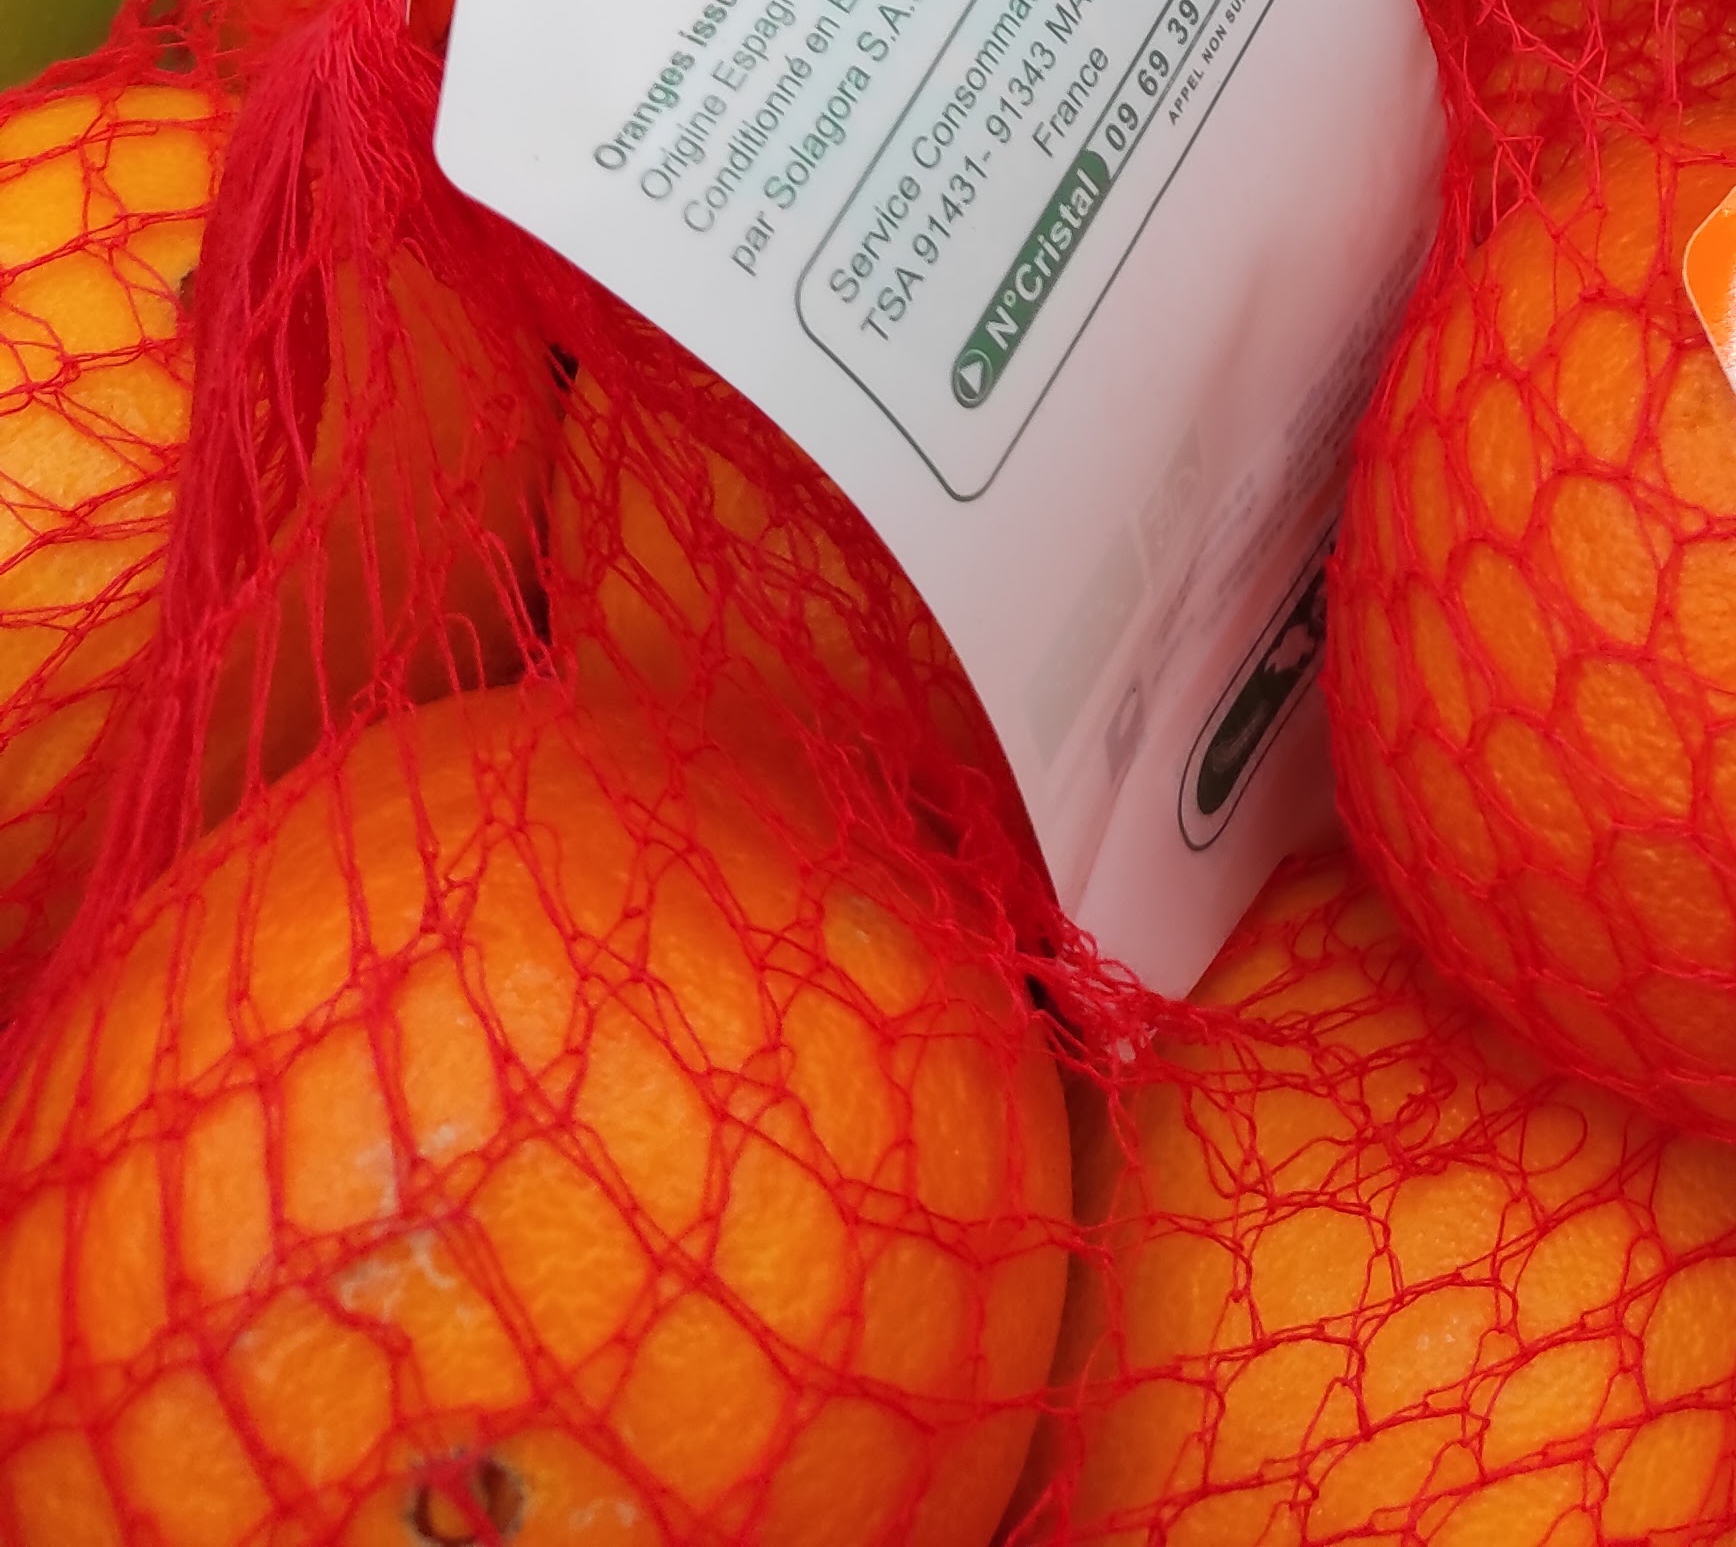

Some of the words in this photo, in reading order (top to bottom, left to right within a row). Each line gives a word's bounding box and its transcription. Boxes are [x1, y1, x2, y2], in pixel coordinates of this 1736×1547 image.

[594, 50, 696, 171] Oranges
[683, 54, 812, 233] Conditionné
[805, 14, 841, 54] en
[1032, 45, 1109, 159] France
[1166, 65, 1206, 127] APPEL
[1201, 24, 1227, 66] NON
[641, 93, 728, 200] Origine
[730, 210, 775, 277] par
[763, 65, 873, 210] Solagora
[860, 267, 927, 343] TSA
[985, 47, 1058, 144] 91343
[984, 167, 1102, 354] N°Cristal
[1104, 101, 1138, 153] 09
[1137, 50, 1171, 99] 69
[828, 175, 924, 305] Service
